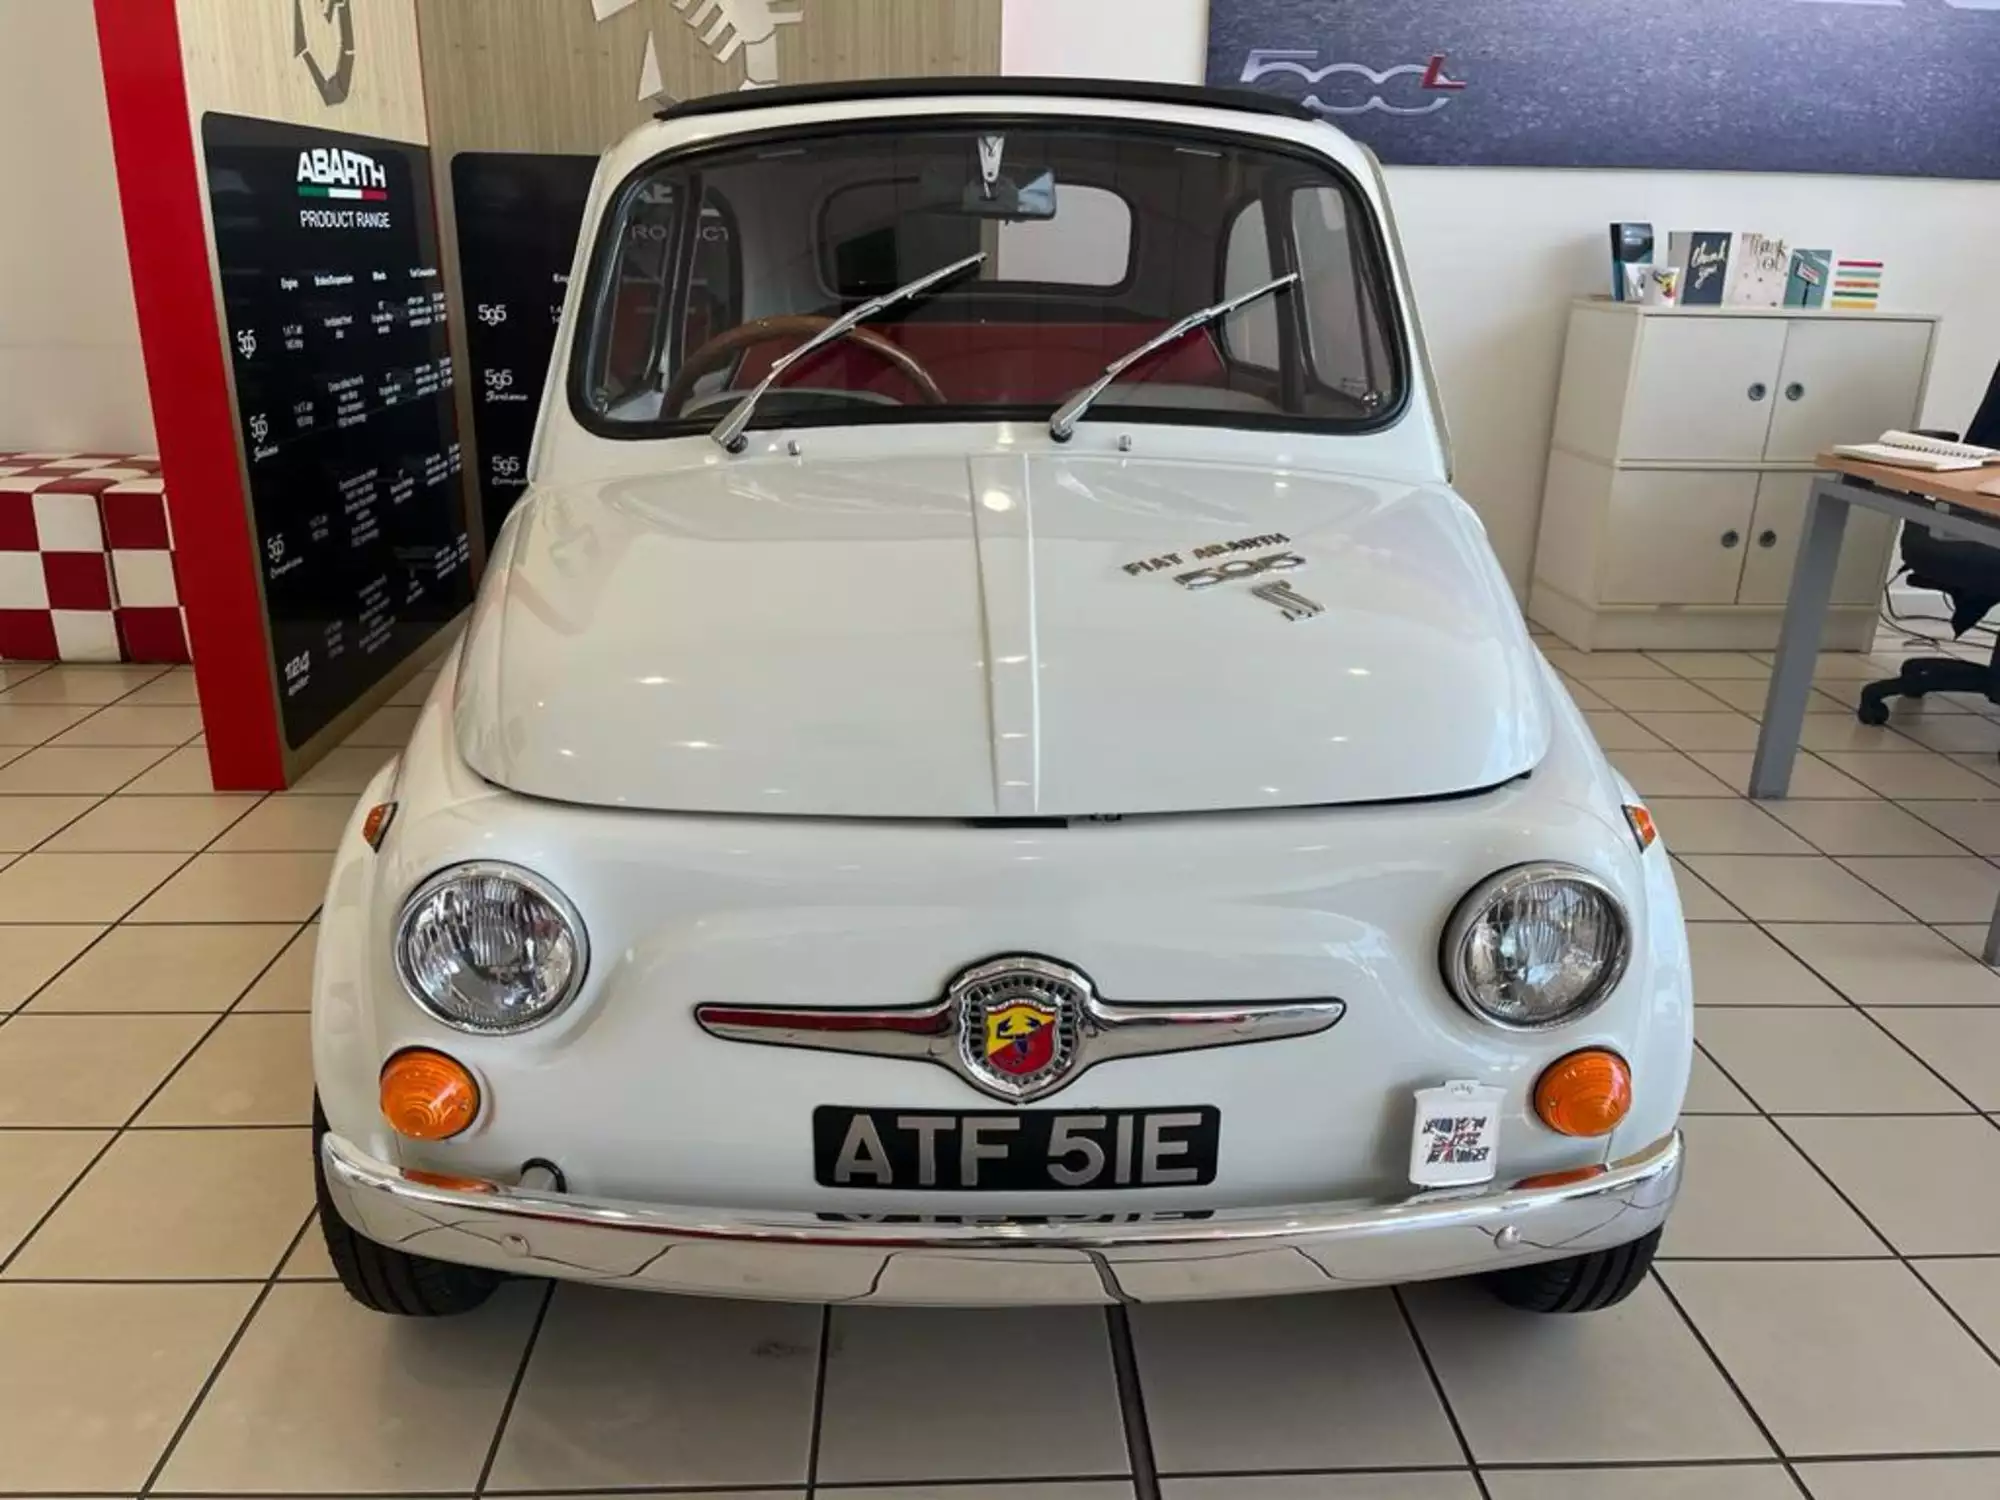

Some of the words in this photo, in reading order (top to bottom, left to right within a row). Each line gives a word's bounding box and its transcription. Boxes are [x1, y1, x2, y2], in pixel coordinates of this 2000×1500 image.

[297, 148, 387, 188] ABARTH
[300, 210, 354, 228] PRODUCT
[356, 212, 391, 229] RANGE
[478, 304, 507, 326] 595
[484, 369, 513, 390] 595
[1122, 552, 1183, 576] FIAT
[1192, 532, 1291, 559] ABARTH
[834, 1114, 1020, 1186] ATF
